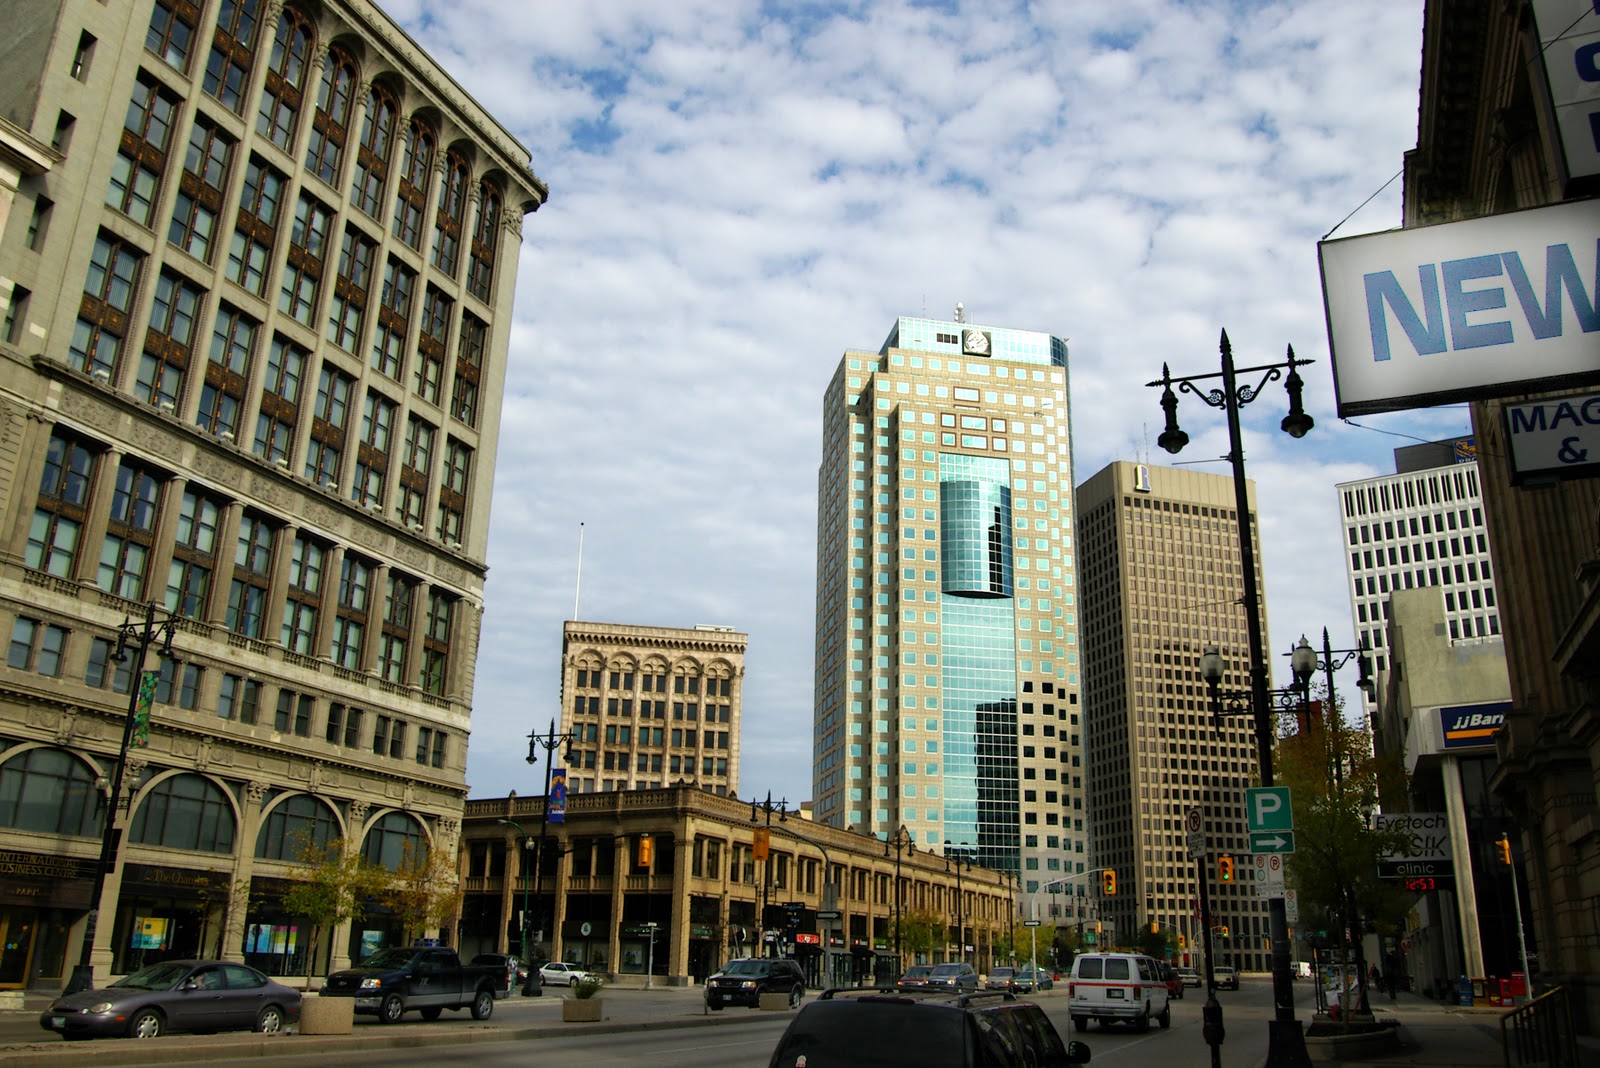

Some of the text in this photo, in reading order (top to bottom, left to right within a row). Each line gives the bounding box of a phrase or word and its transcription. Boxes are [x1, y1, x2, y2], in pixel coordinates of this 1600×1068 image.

[1363, 238, 1600, 362] NEW
[1511, 398, 1600, 434] MAG
[1558, 436, 1588, 464] &
[1254, 793, 1282, 826] P
[1376, 814, 1446, 832] Eyetech
[1380, 836, 1447, 858] SIK
[0, 862, 79, 879] USINESS CENTRE
[1397, 862, 1435, 875] clinic
[1405, 877, 1436, 891] 12:53
